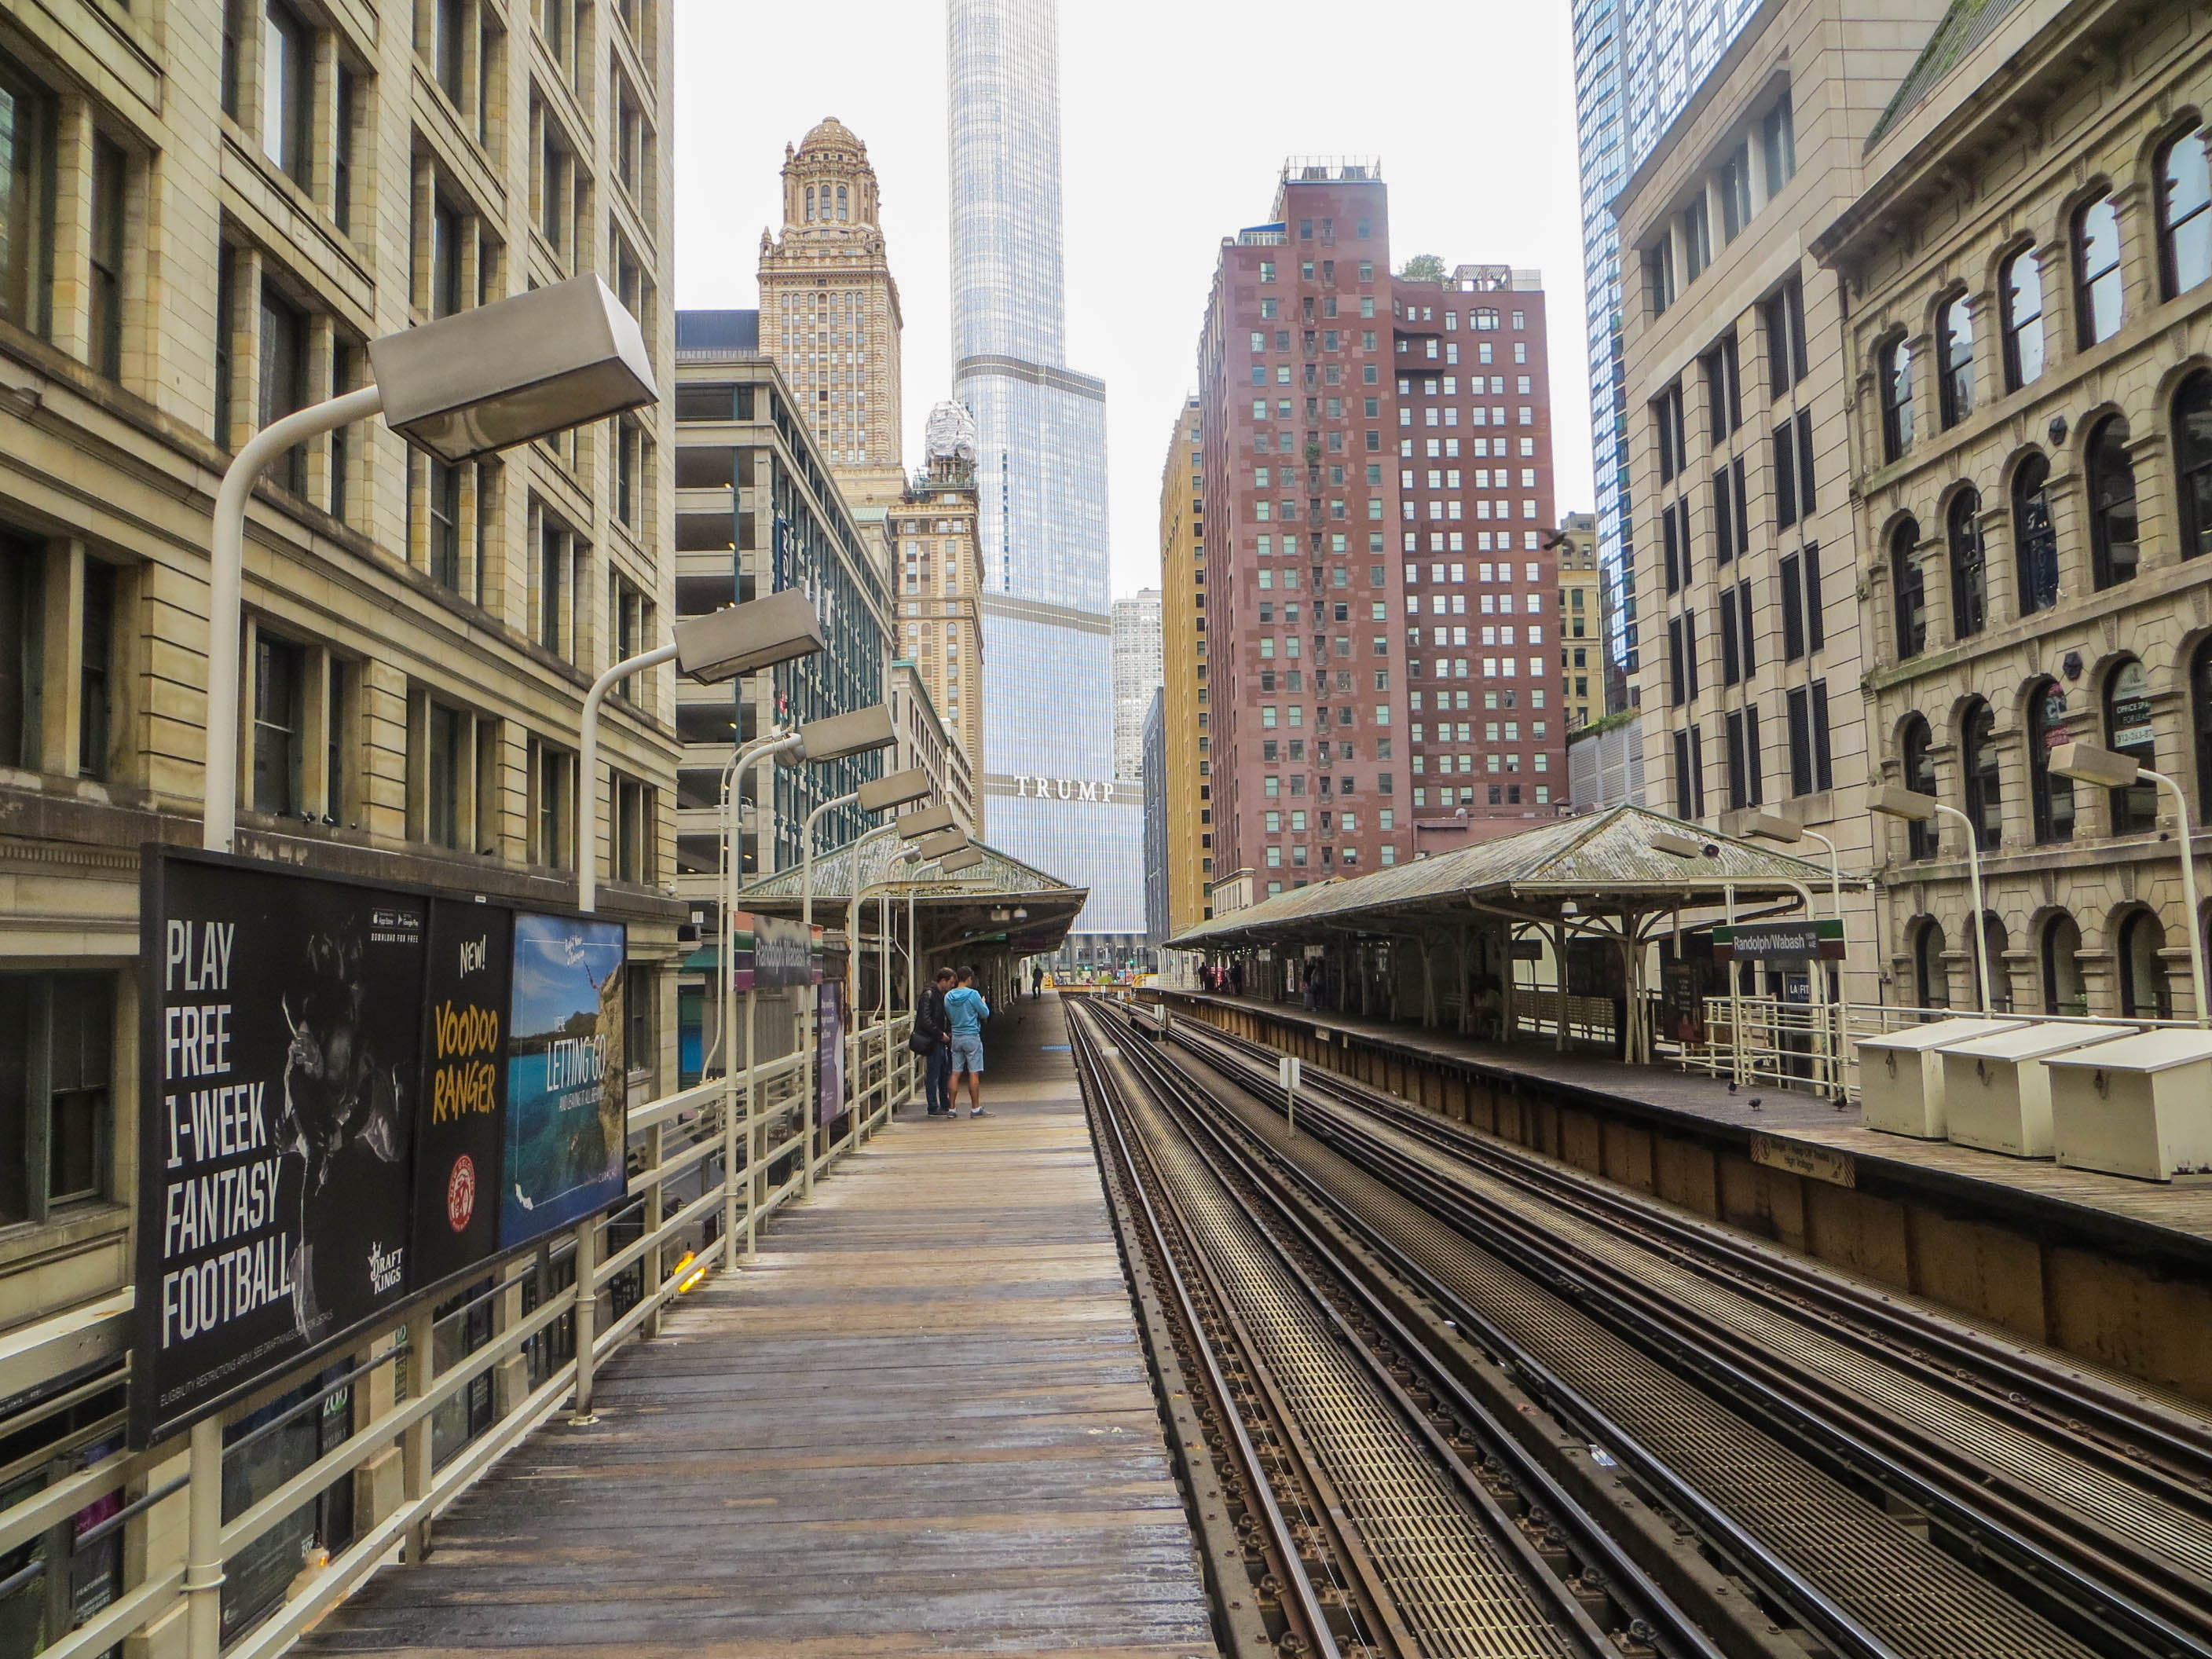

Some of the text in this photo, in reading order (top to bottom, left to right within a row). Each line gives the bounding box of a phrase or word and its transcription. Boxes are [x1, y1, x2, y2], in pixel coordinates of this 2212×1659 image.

[1013, 774, 1114, 804] TRUMP
[166, 919, 235, 991] PLAY
[460, 934, 486, 979] NEW!
[1734, 932, 1805, 954] Randolph/Wabash
[1789, 984, 1798, 994] LA
[166, 1004, 232, 1080] FREE
[436, 1000, 498, 1060] VOODOO
[547, 1034, 606, 1092] LETTING GO
[433, 1060, 496, 1126] RANGER
[165, 1081, 267, 1169] 1-WEEK
[164, 1156, 282, 1258] FANTASY
[163, 1232, 296, 1350] FOOTBALL.
[371, 1247, 403, 1282] DRAFT
[375, 1266, 401, 1295] KINGS
